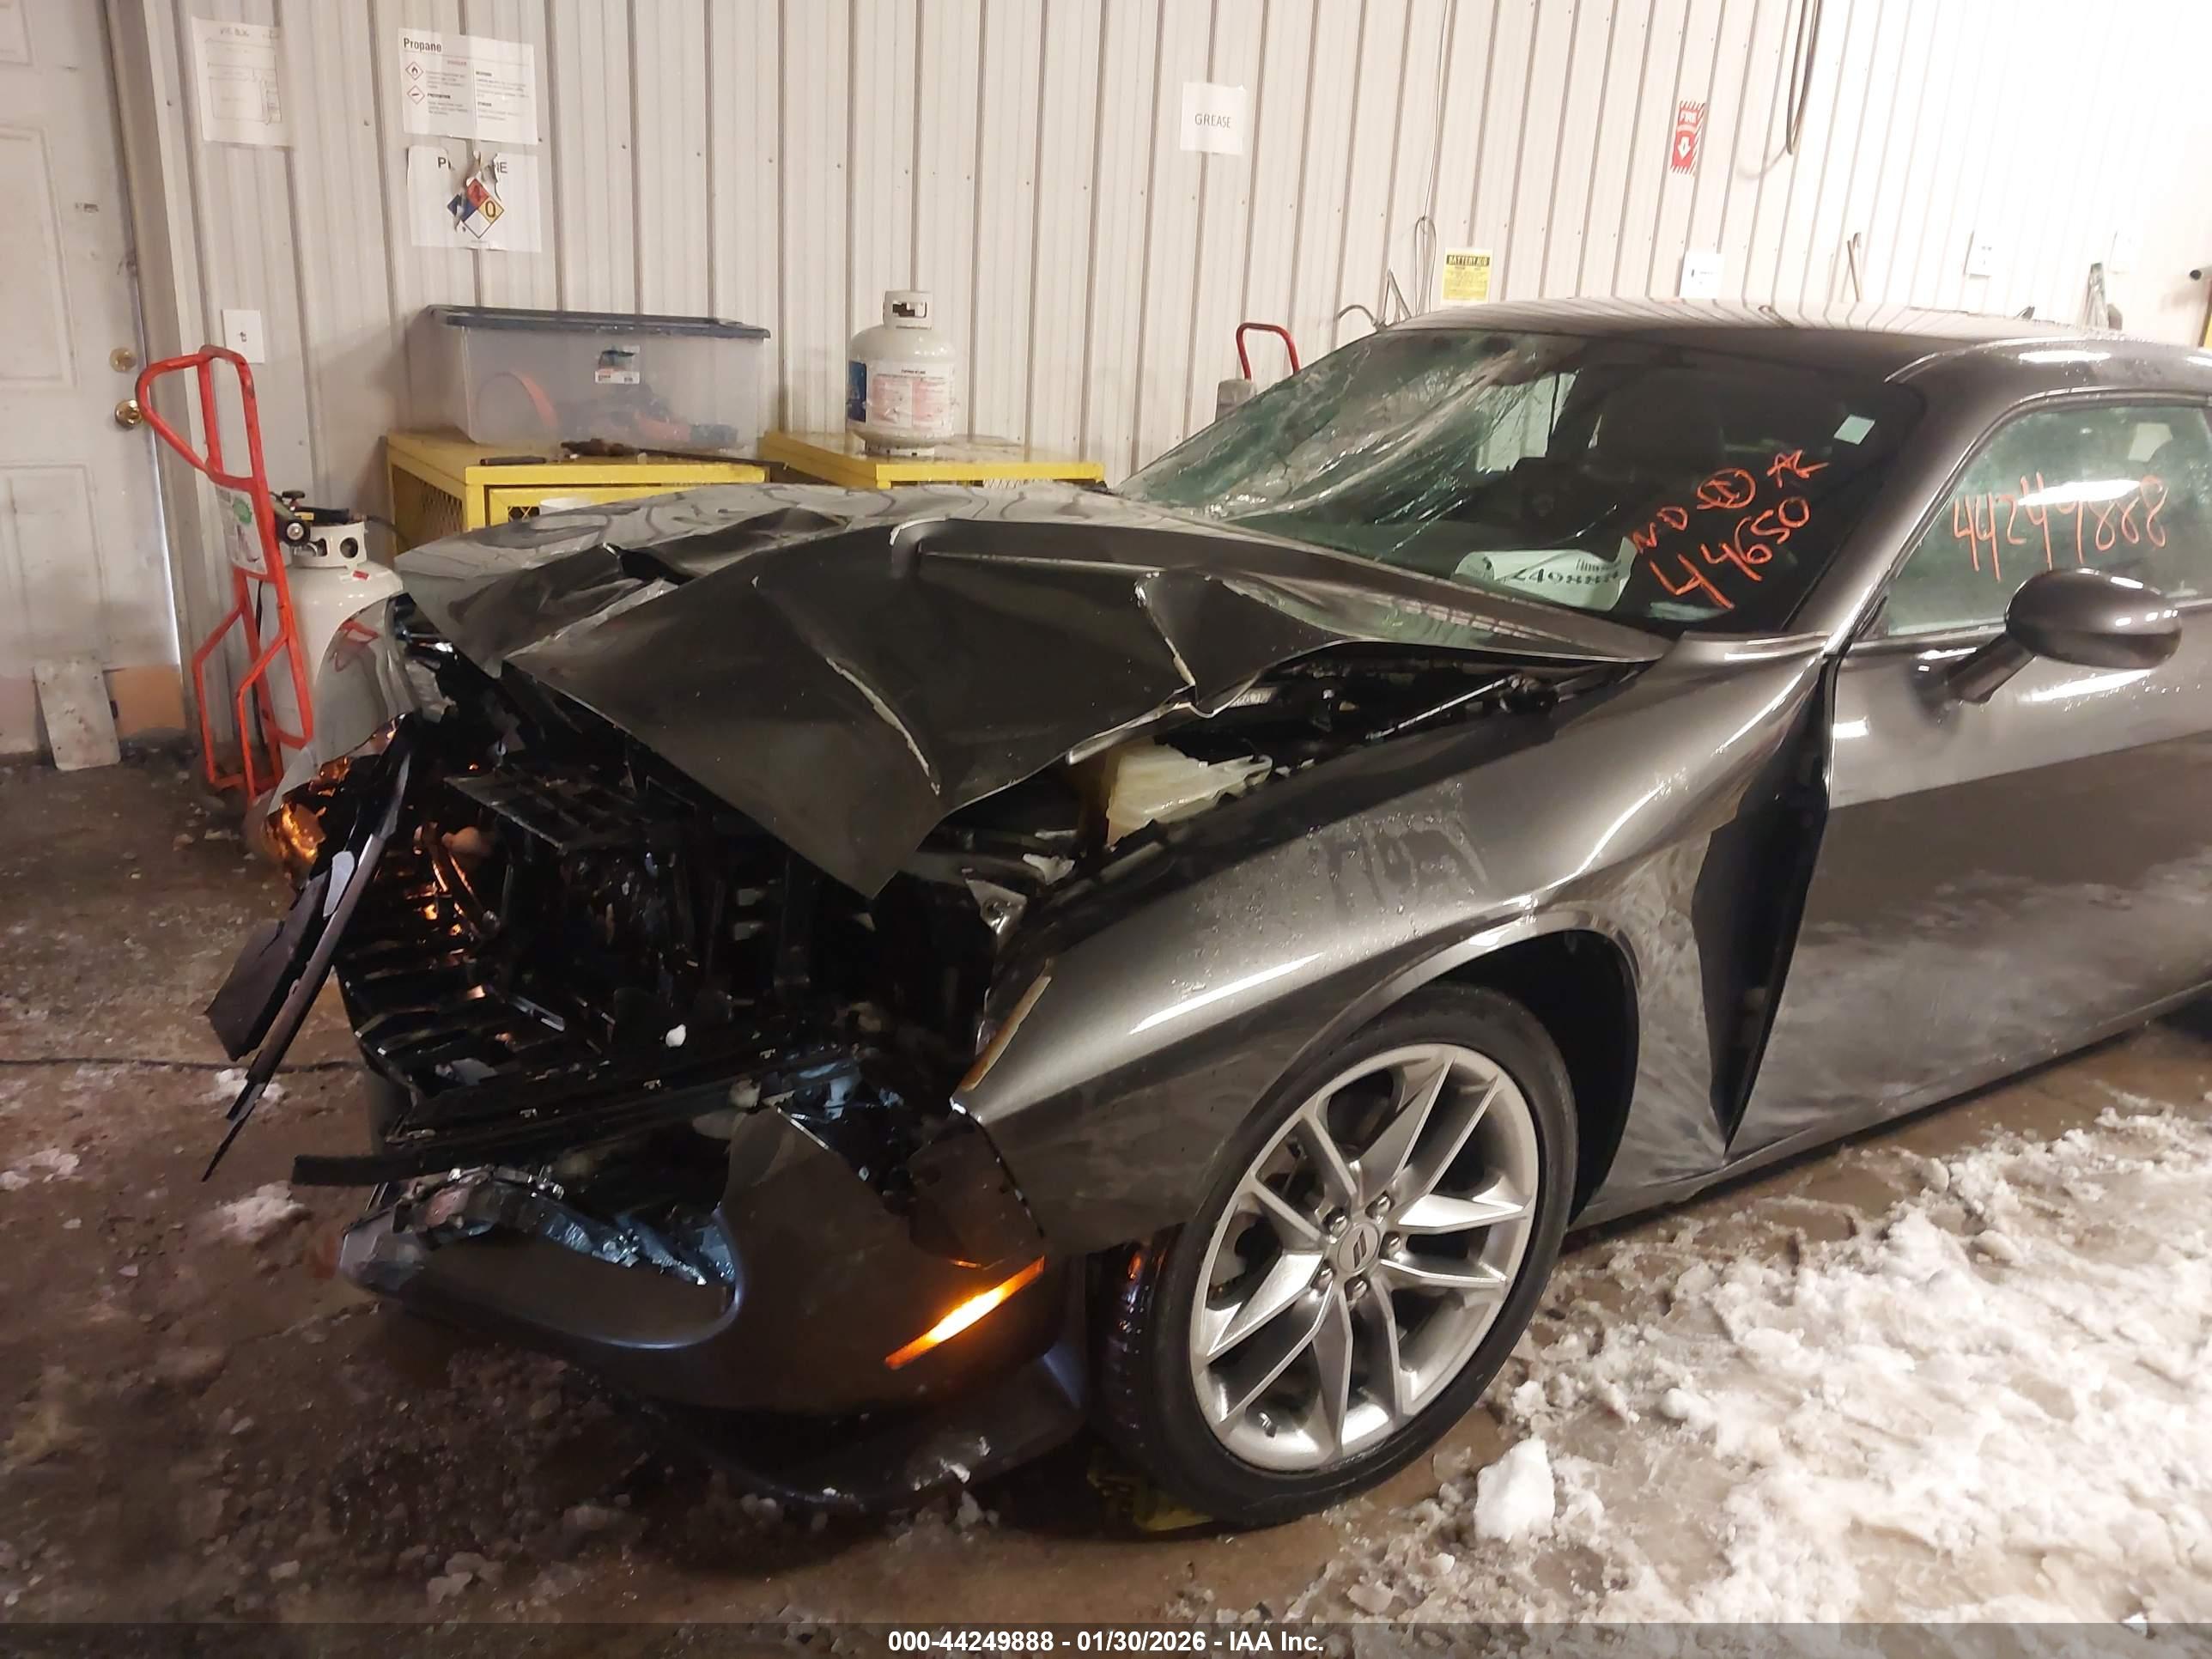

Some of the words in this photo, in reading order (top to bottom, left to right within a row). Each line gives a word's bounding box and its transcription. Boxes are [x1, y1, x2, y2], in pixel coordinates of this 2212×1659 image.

[404, 37, 442, 53] Propane
[1194, 113, 1231, 128] GREASE
[1680, 111, 1698, 124] FIRE
[485, 200, 496, 218] 0
[1954, 471, 2169, 583] 44249888
[1650, 496, 1811, 610] 44650
